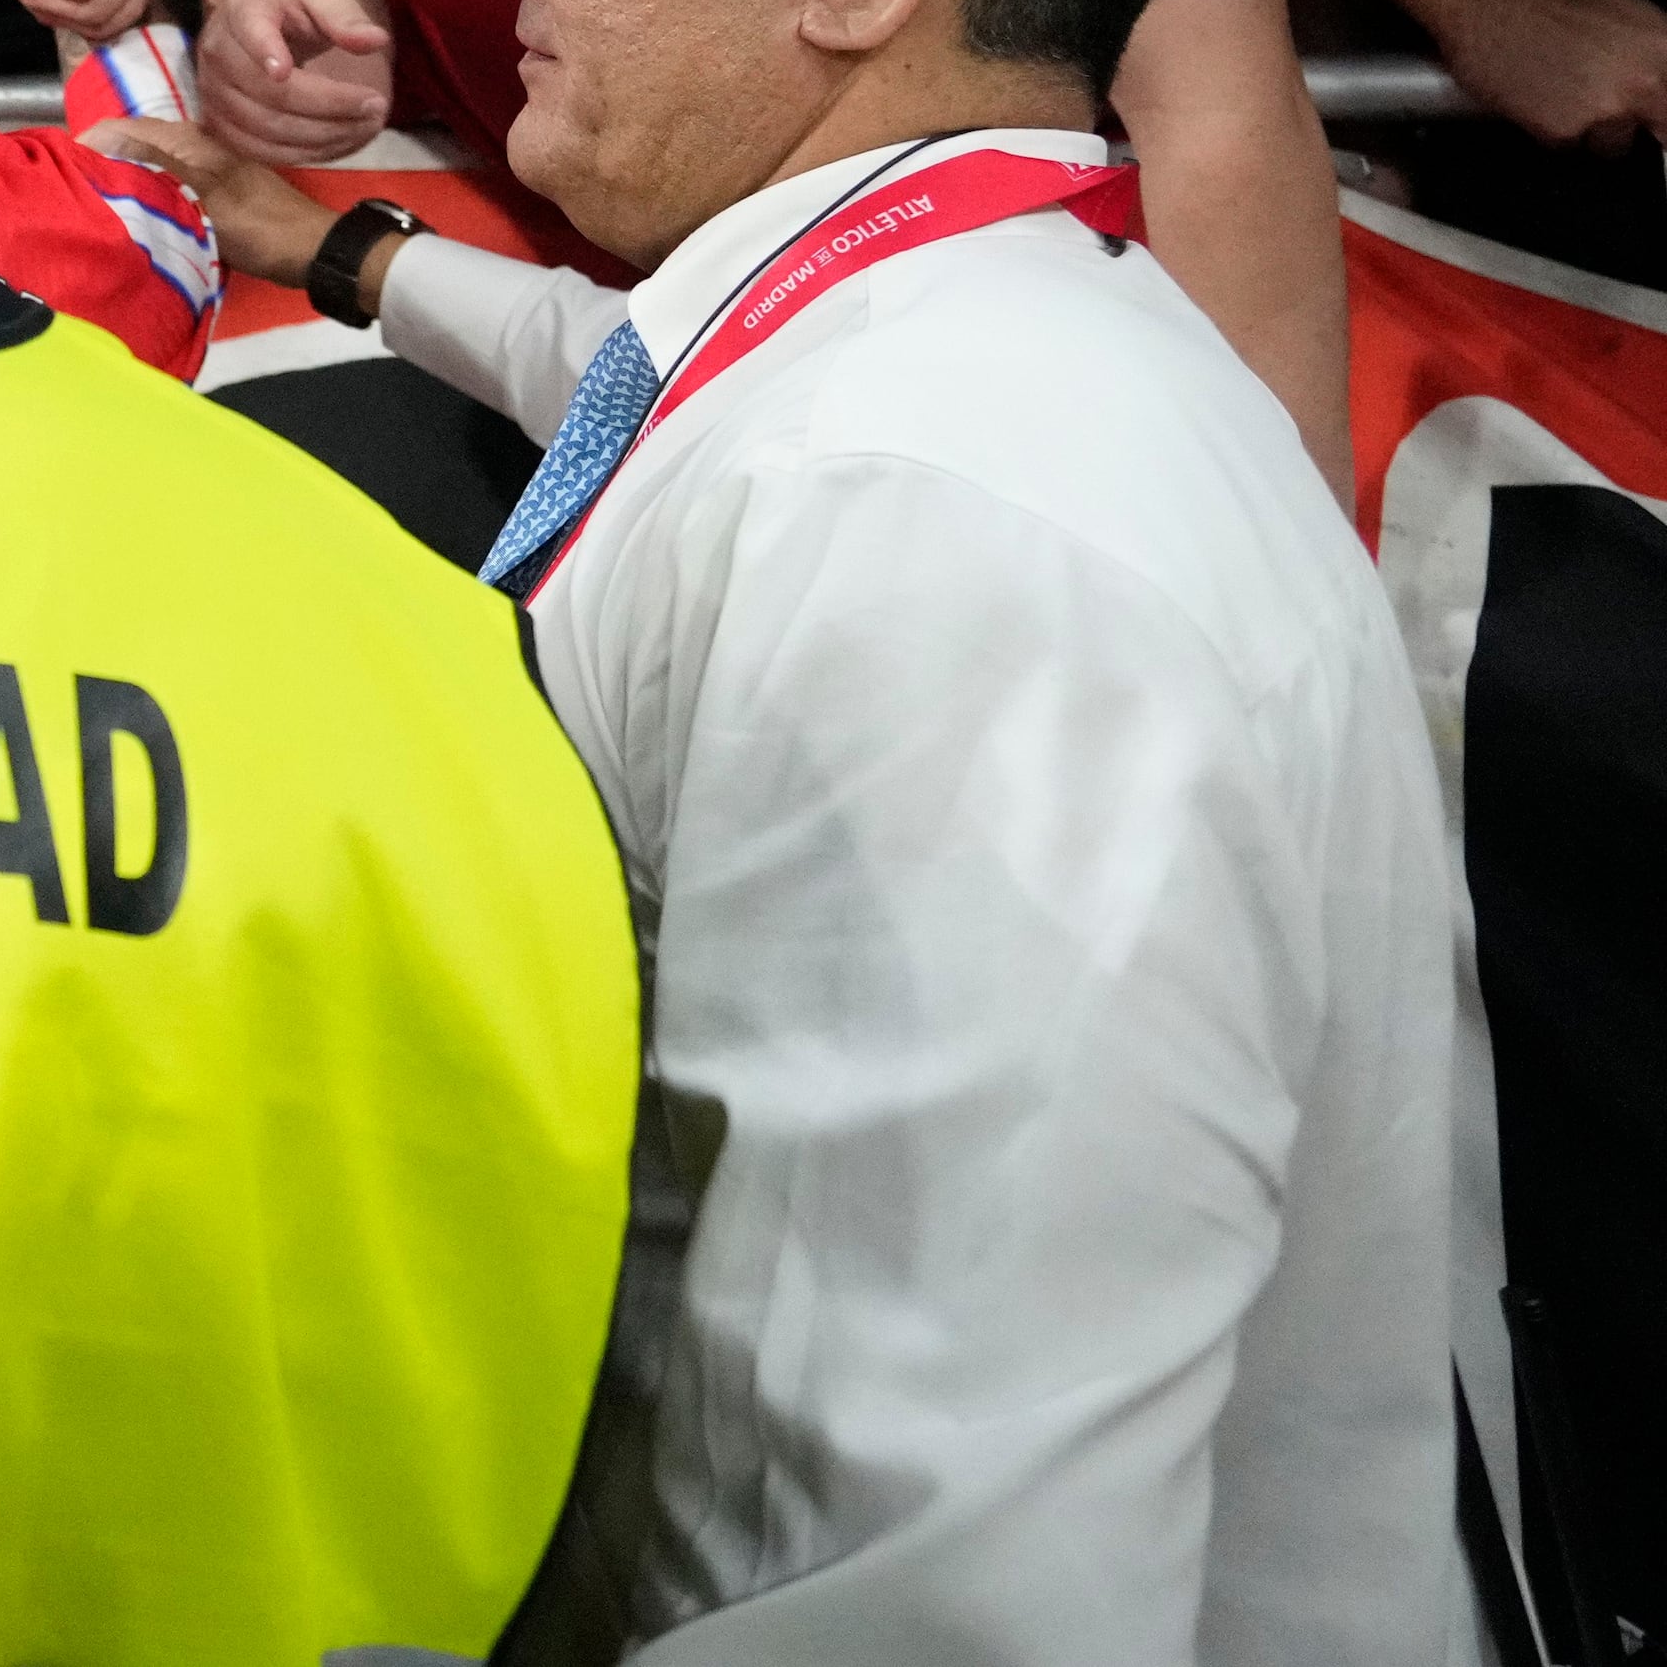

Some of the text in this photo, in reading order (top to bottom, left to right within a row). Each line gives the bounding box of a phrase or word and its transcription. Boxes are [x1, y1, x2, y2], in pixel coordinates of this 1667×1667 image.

[742, 193, 936, 330] ATLÉTICO DE MADRID
